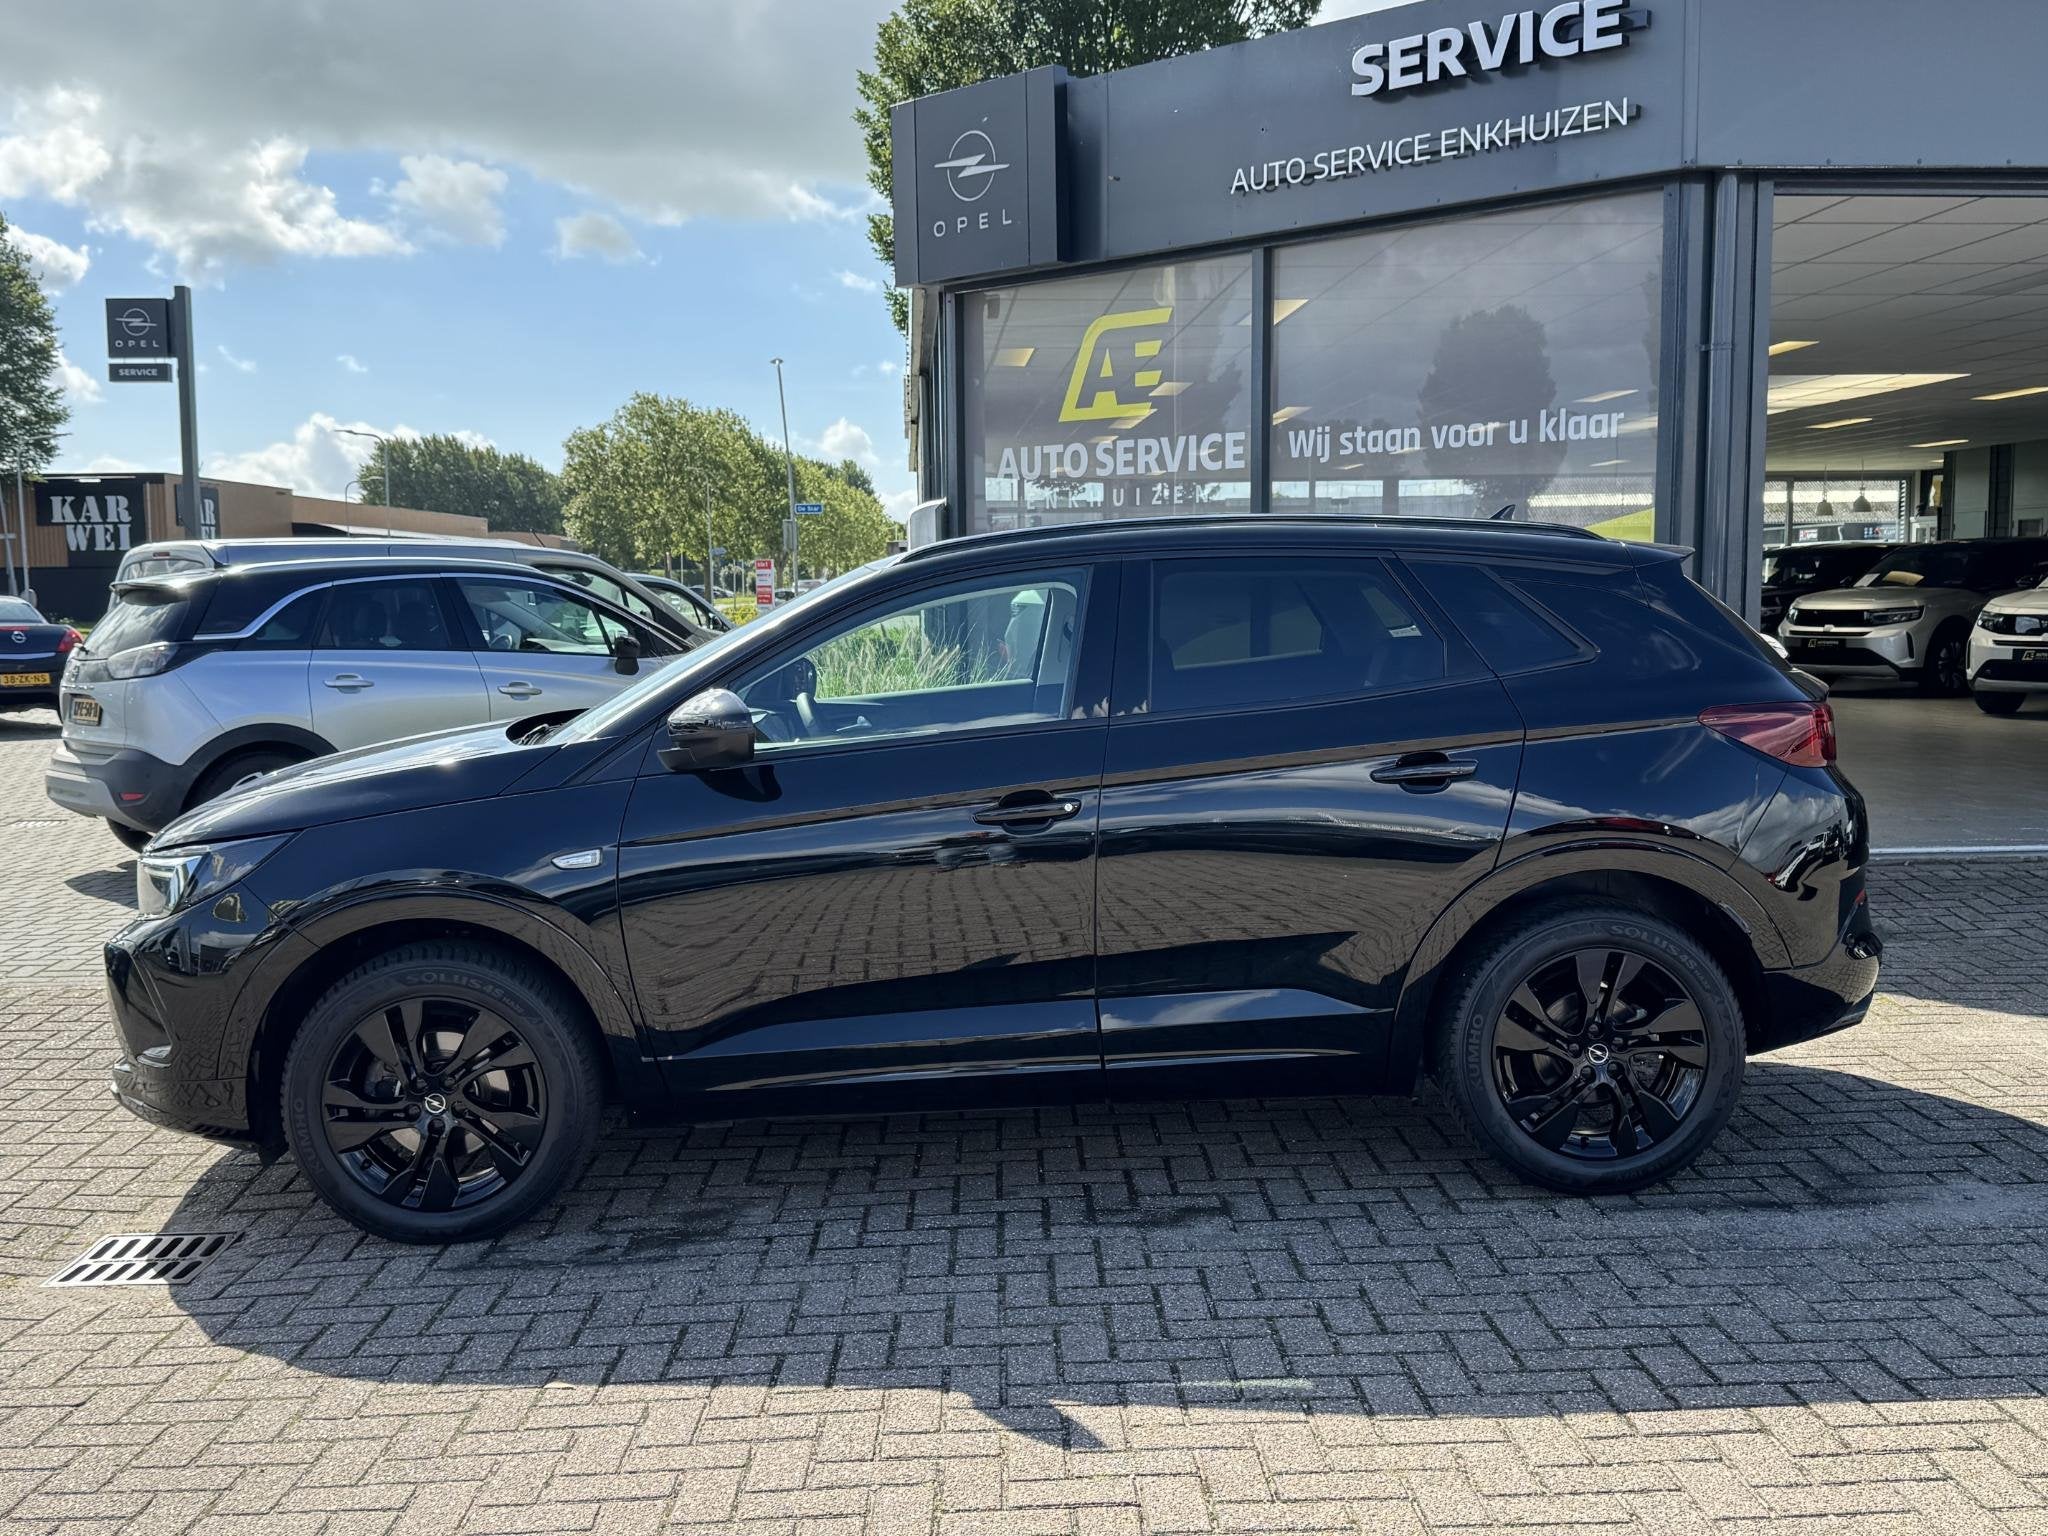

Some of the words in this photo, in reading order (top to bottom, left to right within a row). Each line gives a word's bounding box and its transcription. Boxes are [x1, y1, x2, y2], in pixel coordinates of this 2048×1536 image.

[1352, 0, 1624, 96] SERVICE
[1230, 157, 1305, 195] AUTO
[1314, 133, 1431, 180] SERVICE
[1441, 97, 1628, 157] ENKHUIZEN
[933, 208, 1012, 237] OPEL
[115, 340, 159, 348] OPEL
[118, 368, 158, 376] SERVICE
[1288, 426, 1330, 463] Wij
[1339, 426, 1420, 455] staan
[1431, 421, 1499, 449] voor
[1509, 419, 1527, 444] u
[1539, 408, 1624, 442] klaar
[997, 443, 1088, 480] AUTO
[1096, 431, 1246, 476] SERVICE
[49, 495, 132, 523] KAR
[1027, 485, 1209, 510] ENKHUIZEN
[65, 524, 132, 551] WEI
